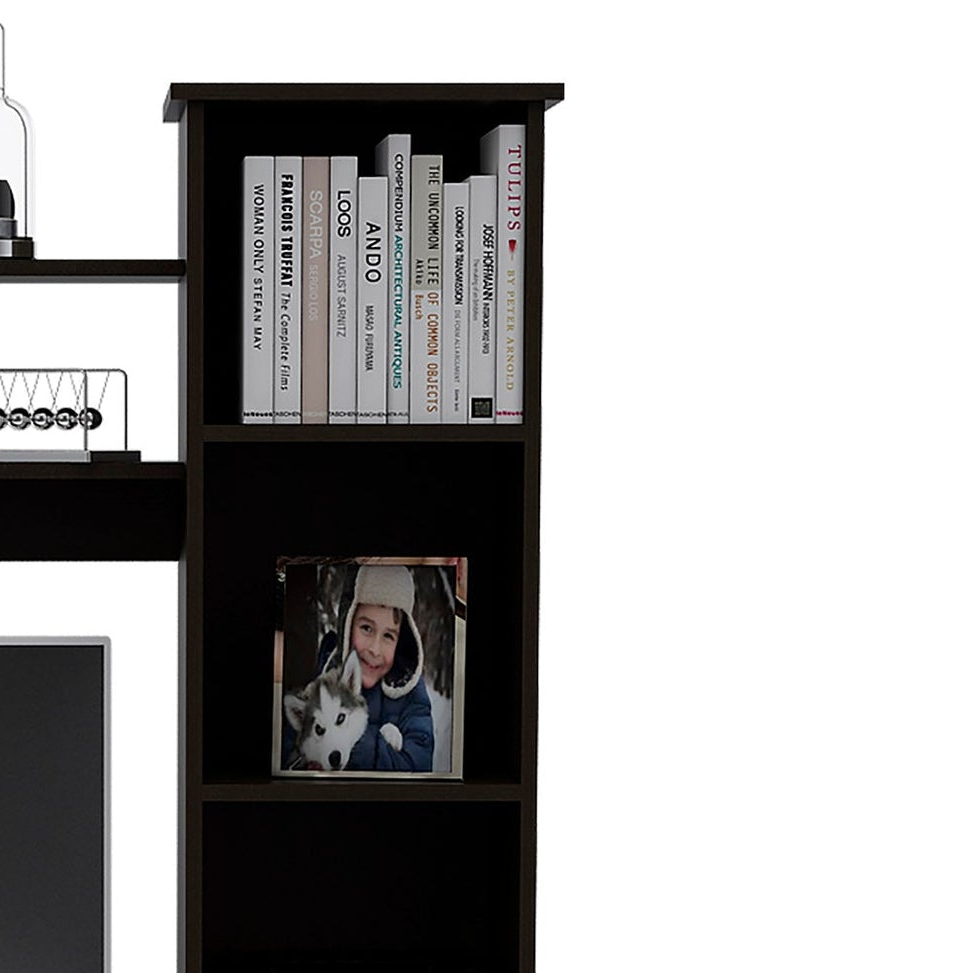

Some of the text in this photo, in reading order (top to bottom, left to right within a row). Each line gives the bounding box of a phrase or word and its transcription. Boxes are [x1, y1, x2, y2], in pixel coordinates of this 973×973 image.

[281, 174, 293, 231] FRANCOIS
[309, 191, 322, 259] SCARPA
[337, 190, 350, 337] LOOS AUGUST SARNITZ
[366, 223, 381, 283] ANDO
[455, 240, 464, 252] FOR
[482, 224, 493, 249] JOSEF
[254, 185, 264, 350] WOMAN ONLY STEFAN MAY
[393, 154, 403, 388] COMPENDIUM ARCHITECTURAL ANTIQUES
[427, 165, 439, 412] THE UNCOMMON LIFE OF COMMON OBJECTS
[482, 251, 494, 301] HOFFMANN
[506, 145, 521, 391] TULIPS BY PETER ARNOLD
[281, 293, 291, 310] The
[415, 294, 423, 319] Busch
[279, 314, 291, 360] Complete
[281, 365, 290, 390] Films
